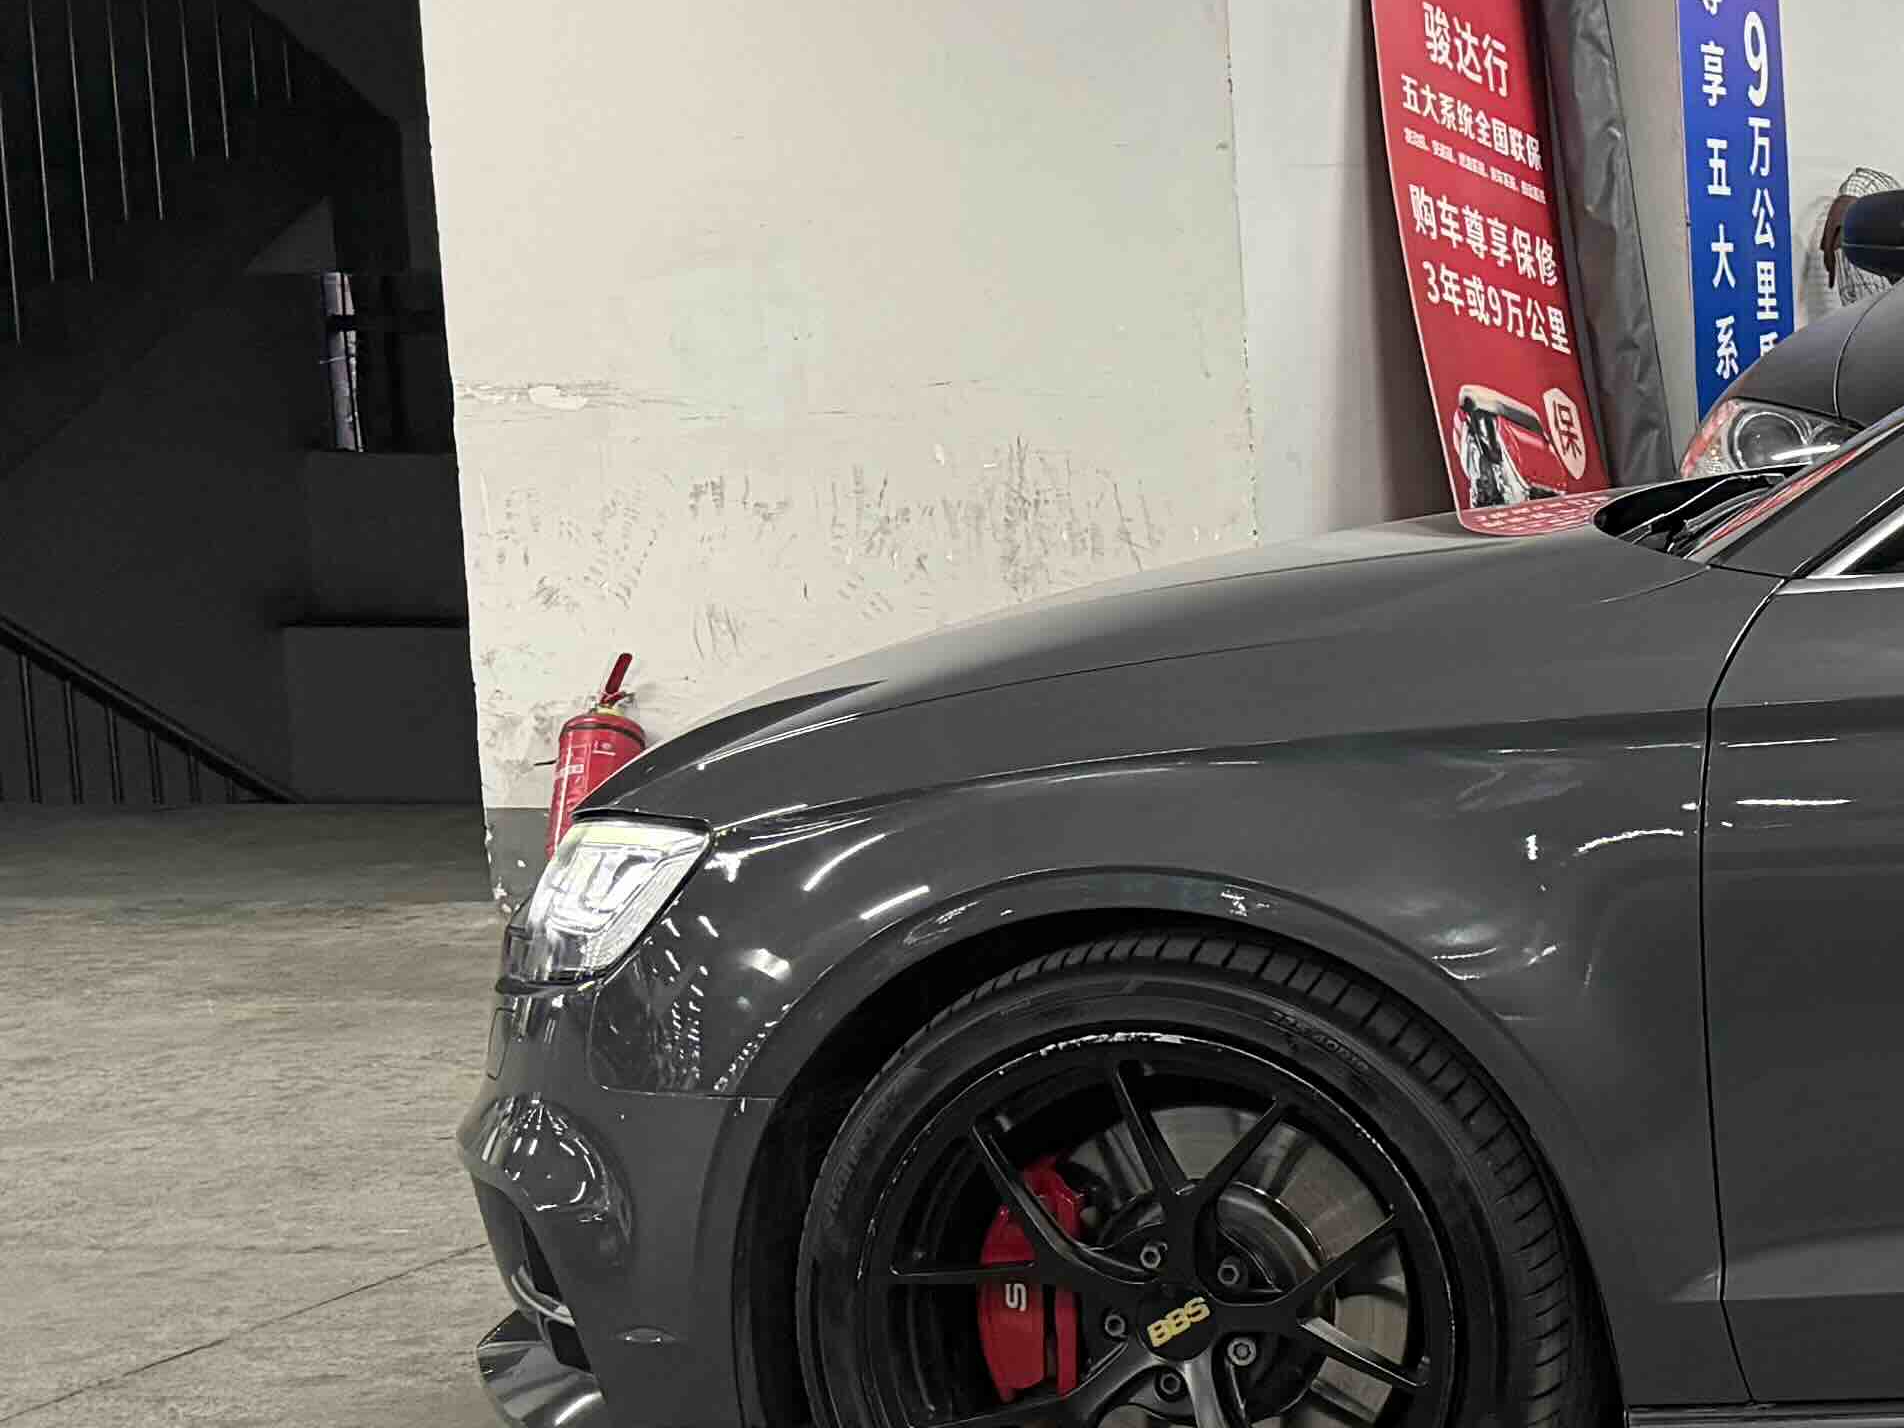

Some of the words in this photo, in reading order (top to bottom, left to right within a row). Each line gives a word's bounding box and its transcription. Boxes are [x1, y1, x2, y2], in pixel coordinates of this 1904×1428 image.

[1422, 1, 1509, 98] 骏达行
[1401, 74, 1543, 172] 五大系统全国联保
[1408, 183, 1559, 287] 购车尊享保修
[1422, 260, 1572, 355] 3年或9万公里
[1552, 401, 1583, 460] 保
[1146, 1296, 1211, 1348] BBS
